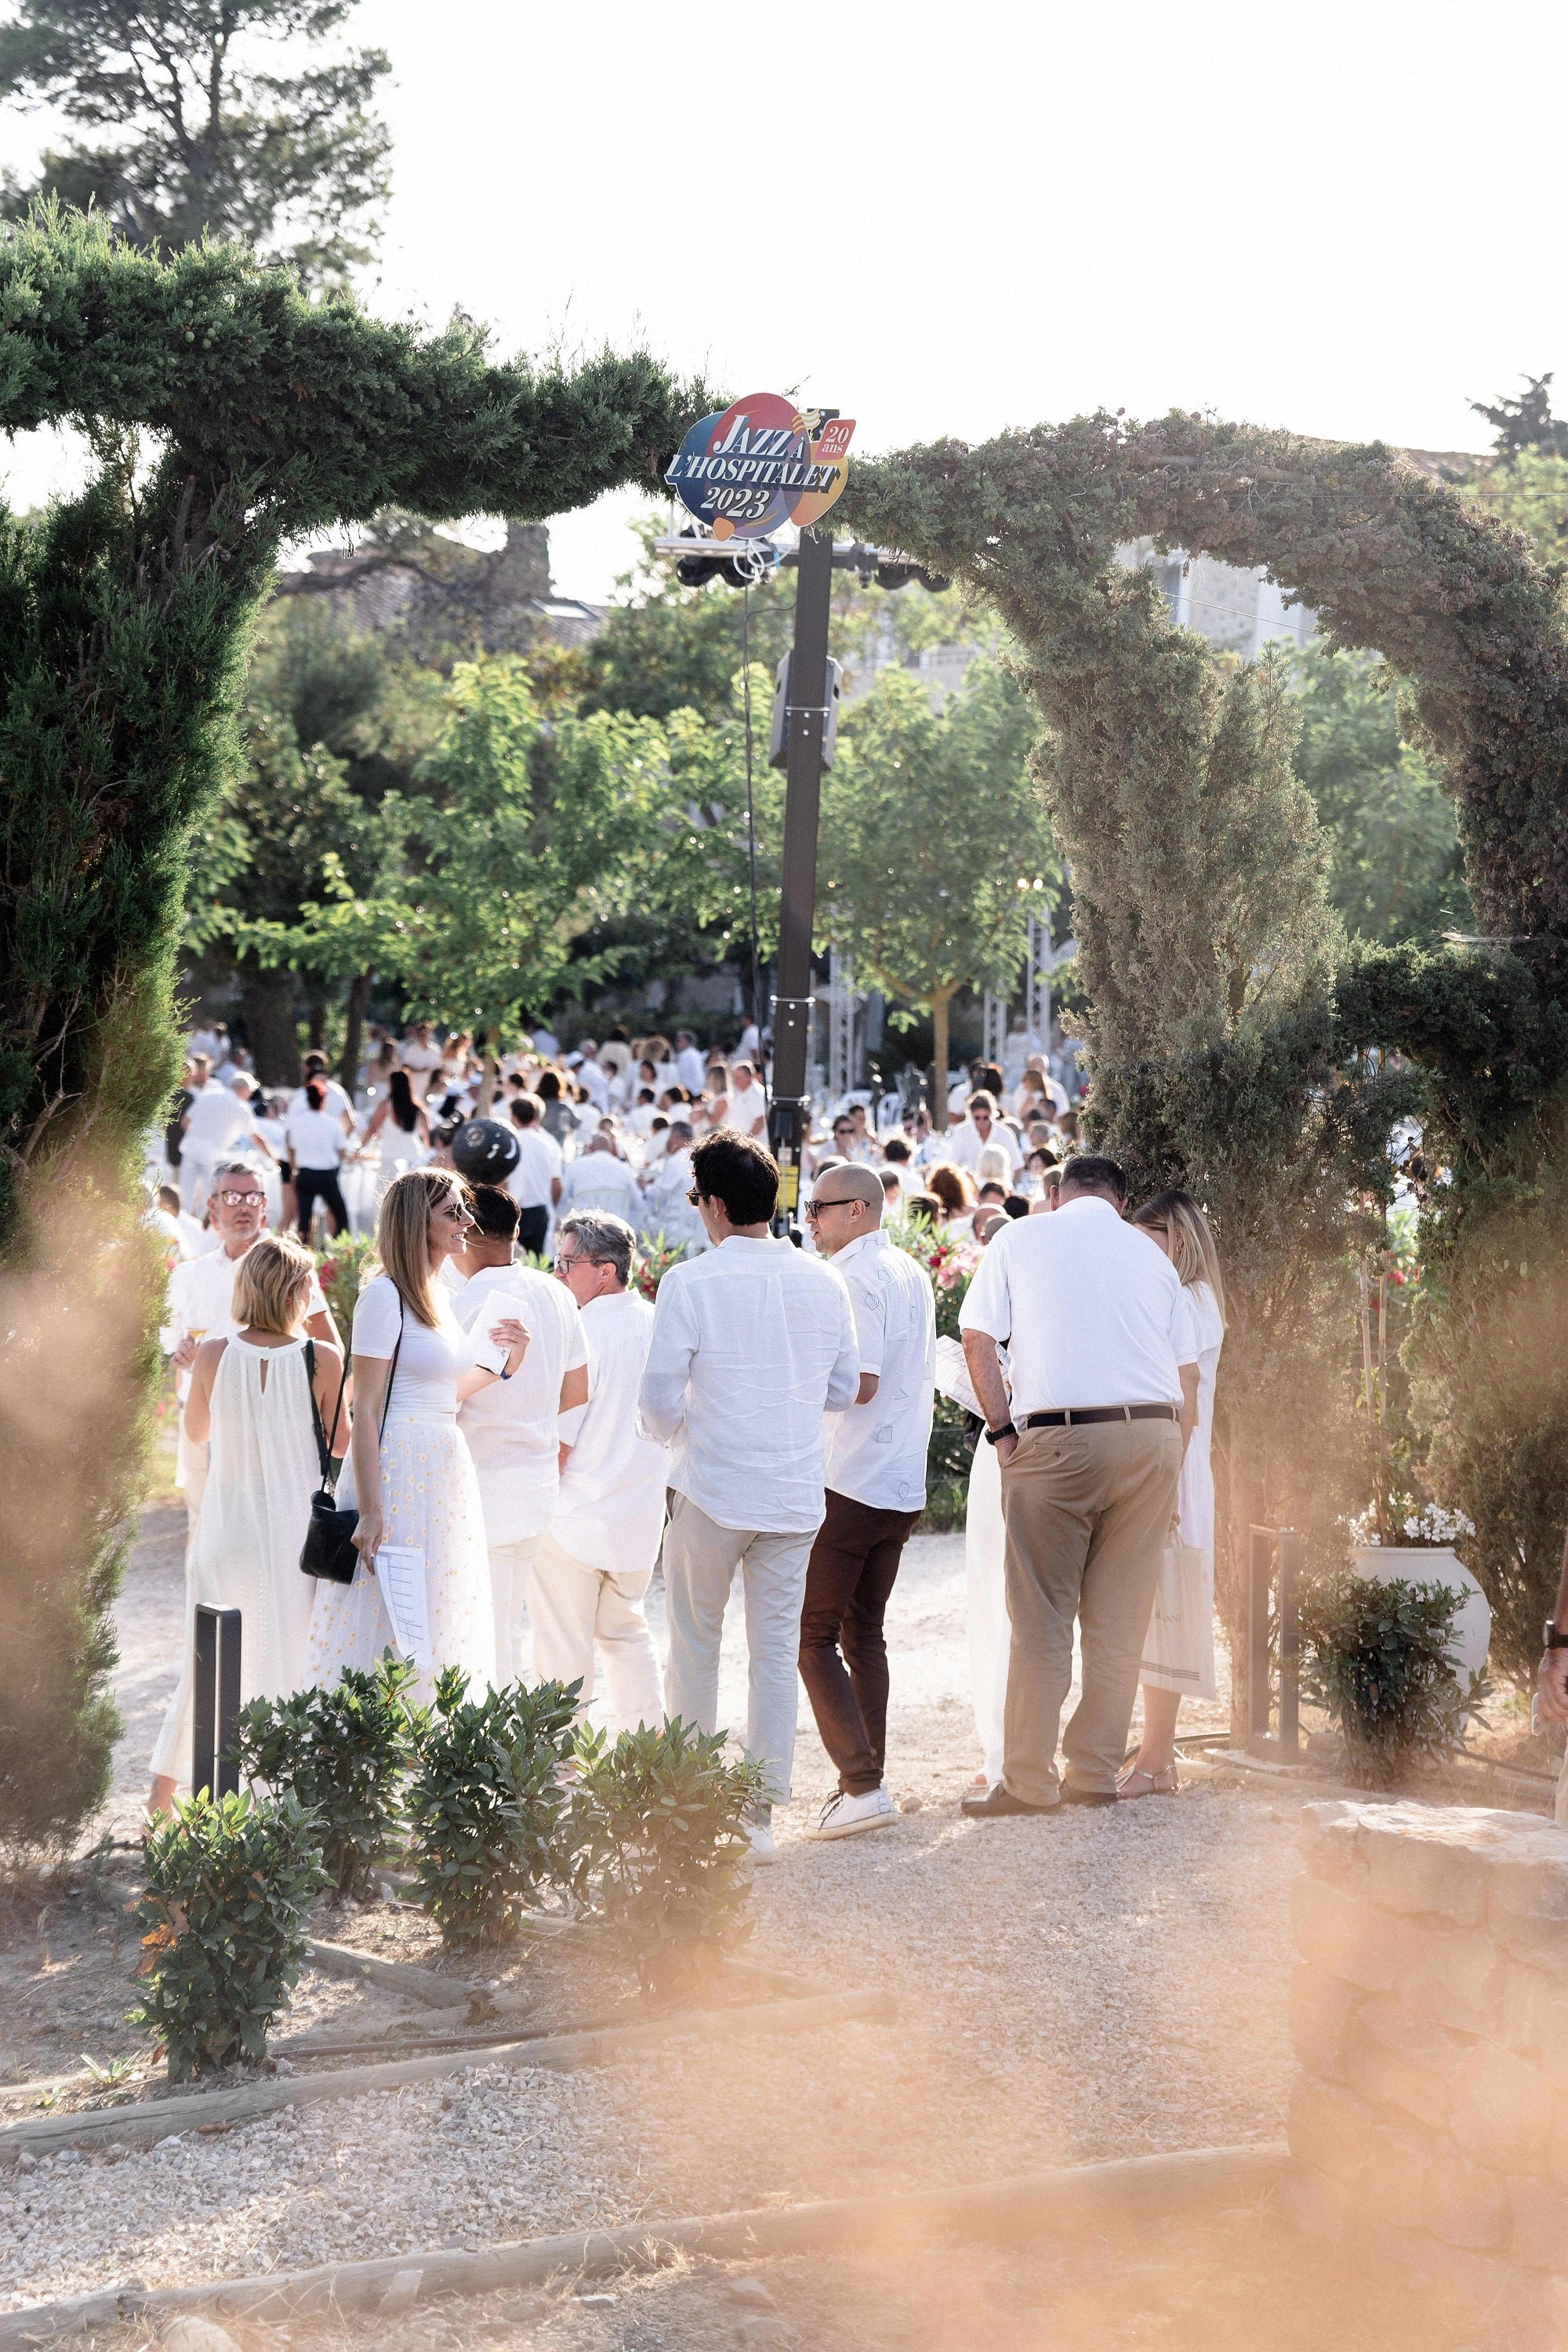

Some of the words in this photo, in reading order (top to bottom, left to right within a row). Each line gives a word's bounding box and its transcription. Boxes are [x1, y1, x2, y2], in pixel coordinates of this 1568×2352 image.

[713, 415, 793, 456] JAZZ
[821, 443, 844, 454] ans
[825, 426, 850, 444] 20
[665, 454, 839, 487] L'HOSPITALET
[700, 486, 770, 519] 2023
